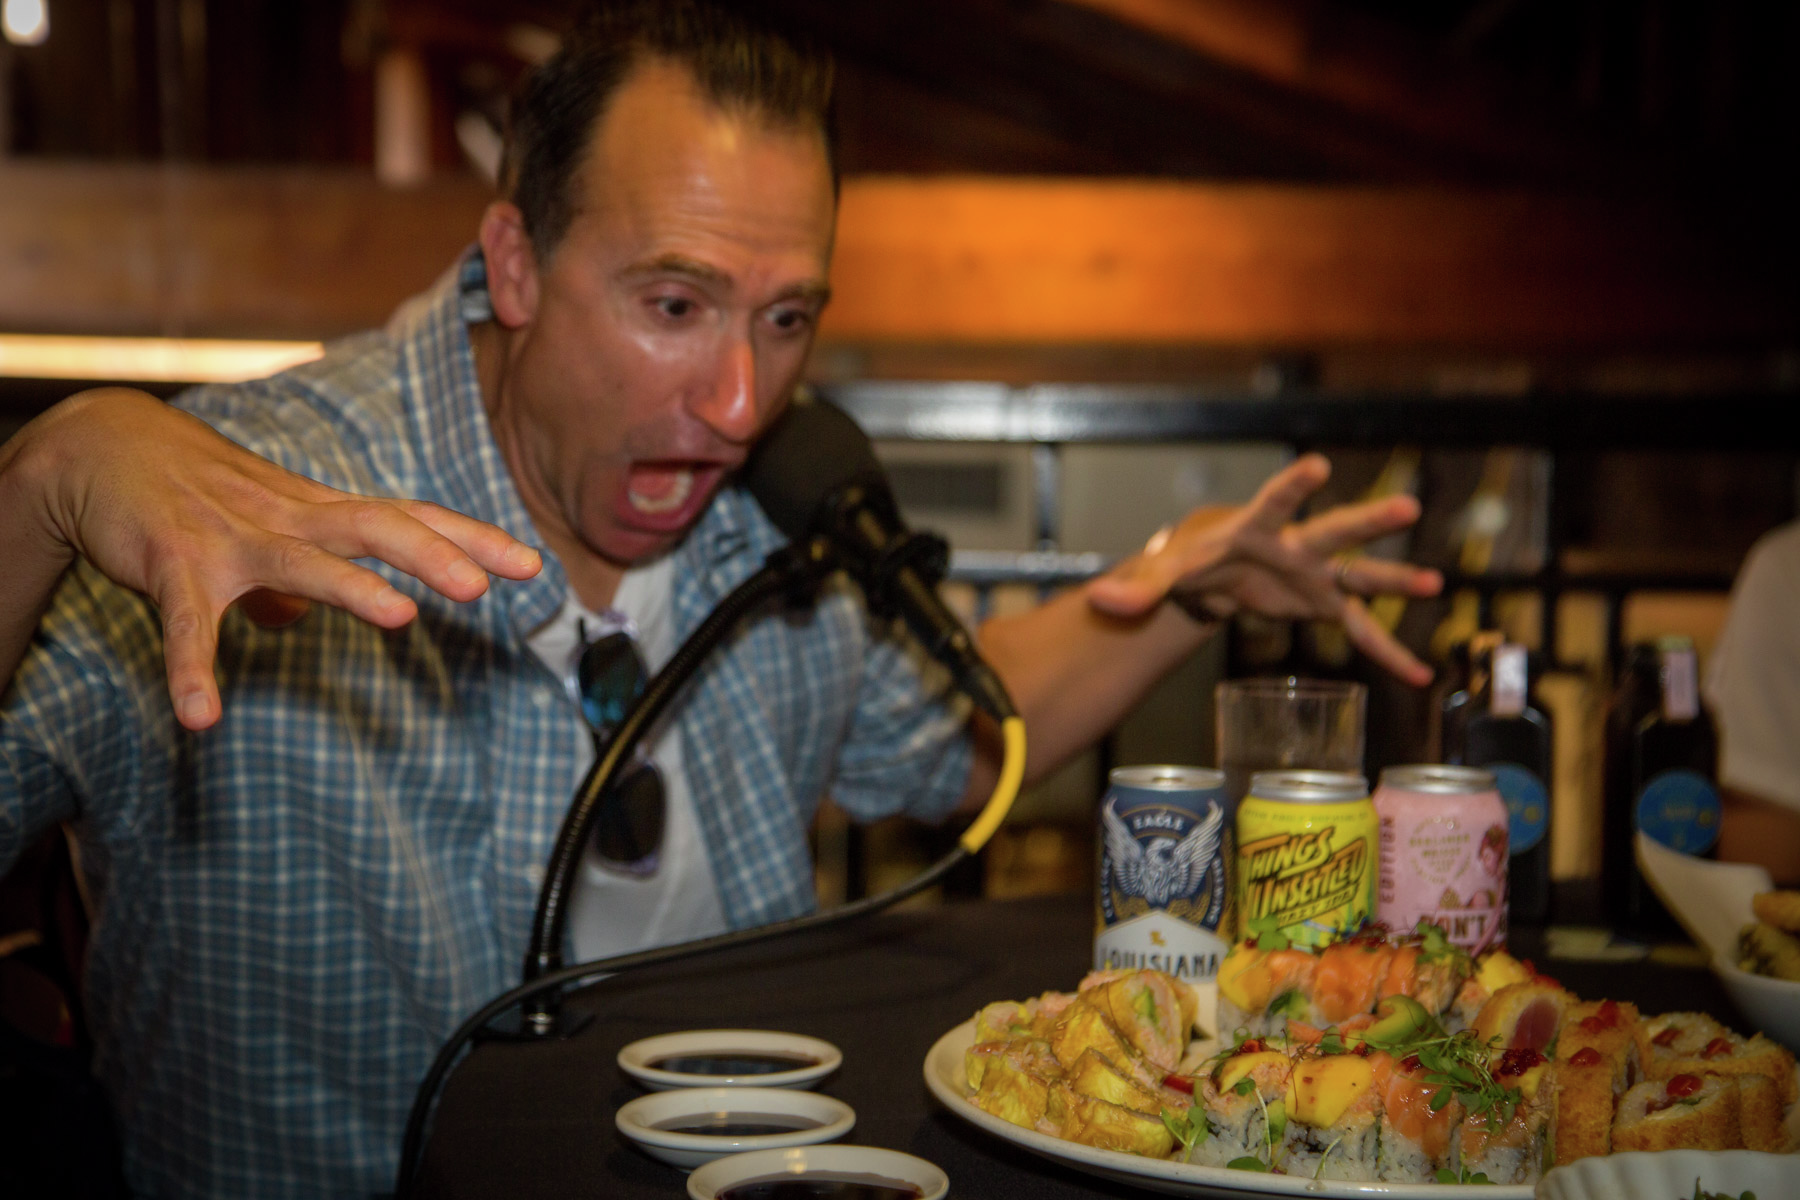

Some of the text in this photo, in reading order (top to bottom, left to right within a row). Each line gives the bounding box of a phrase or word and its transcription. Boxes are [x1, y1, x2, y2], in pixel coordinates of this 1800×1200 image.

[1133, 814, 1185, 831] EAGLE
[1240, 826, 1335, 880] THINGS
[1247, 836, 1367, 920] UNSETTLED
